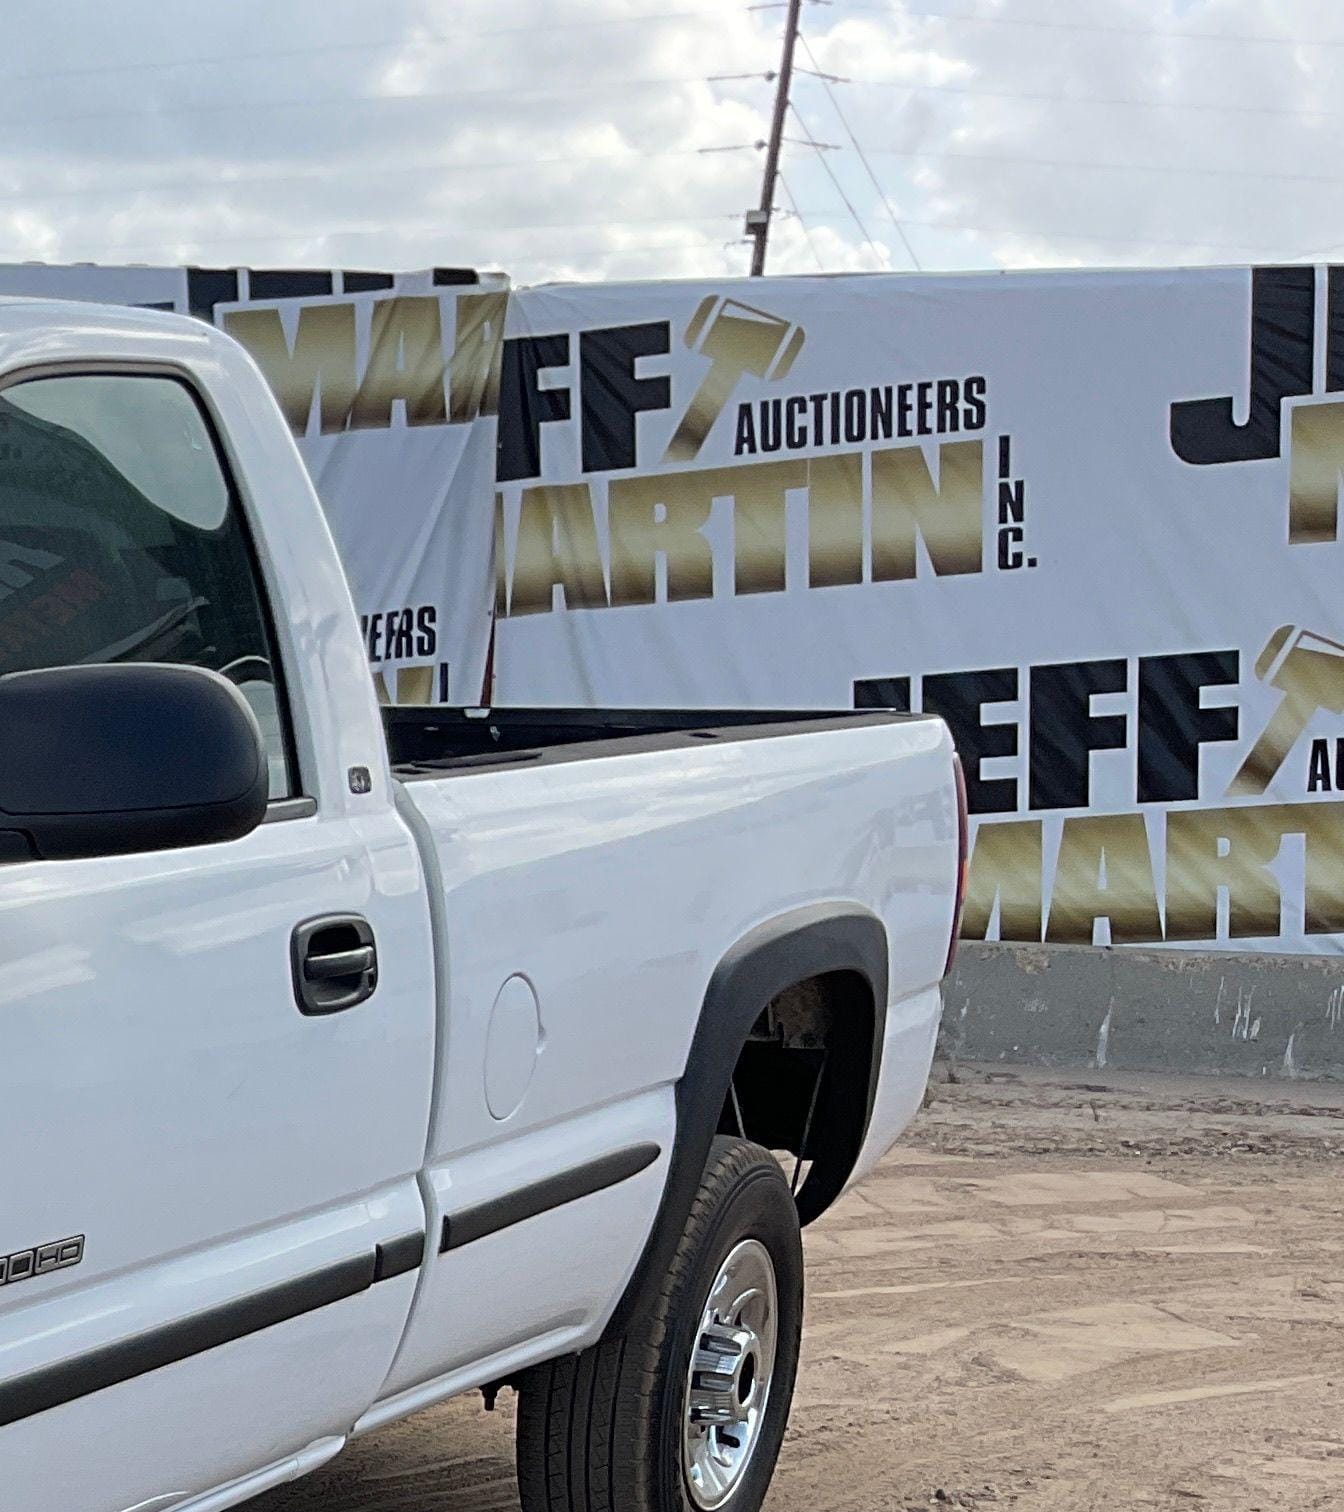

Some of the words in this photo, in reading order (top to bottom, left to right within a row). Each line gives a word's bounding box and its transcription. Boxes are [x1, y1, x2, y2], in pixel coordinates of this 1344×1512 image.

[734, 376, 987, 455] AUCTIONEERS
[495, 439, 984, 618] ARTIN
[998, 435, 1038, 570] INC.
[853, 649, 1240, 814] EFF
